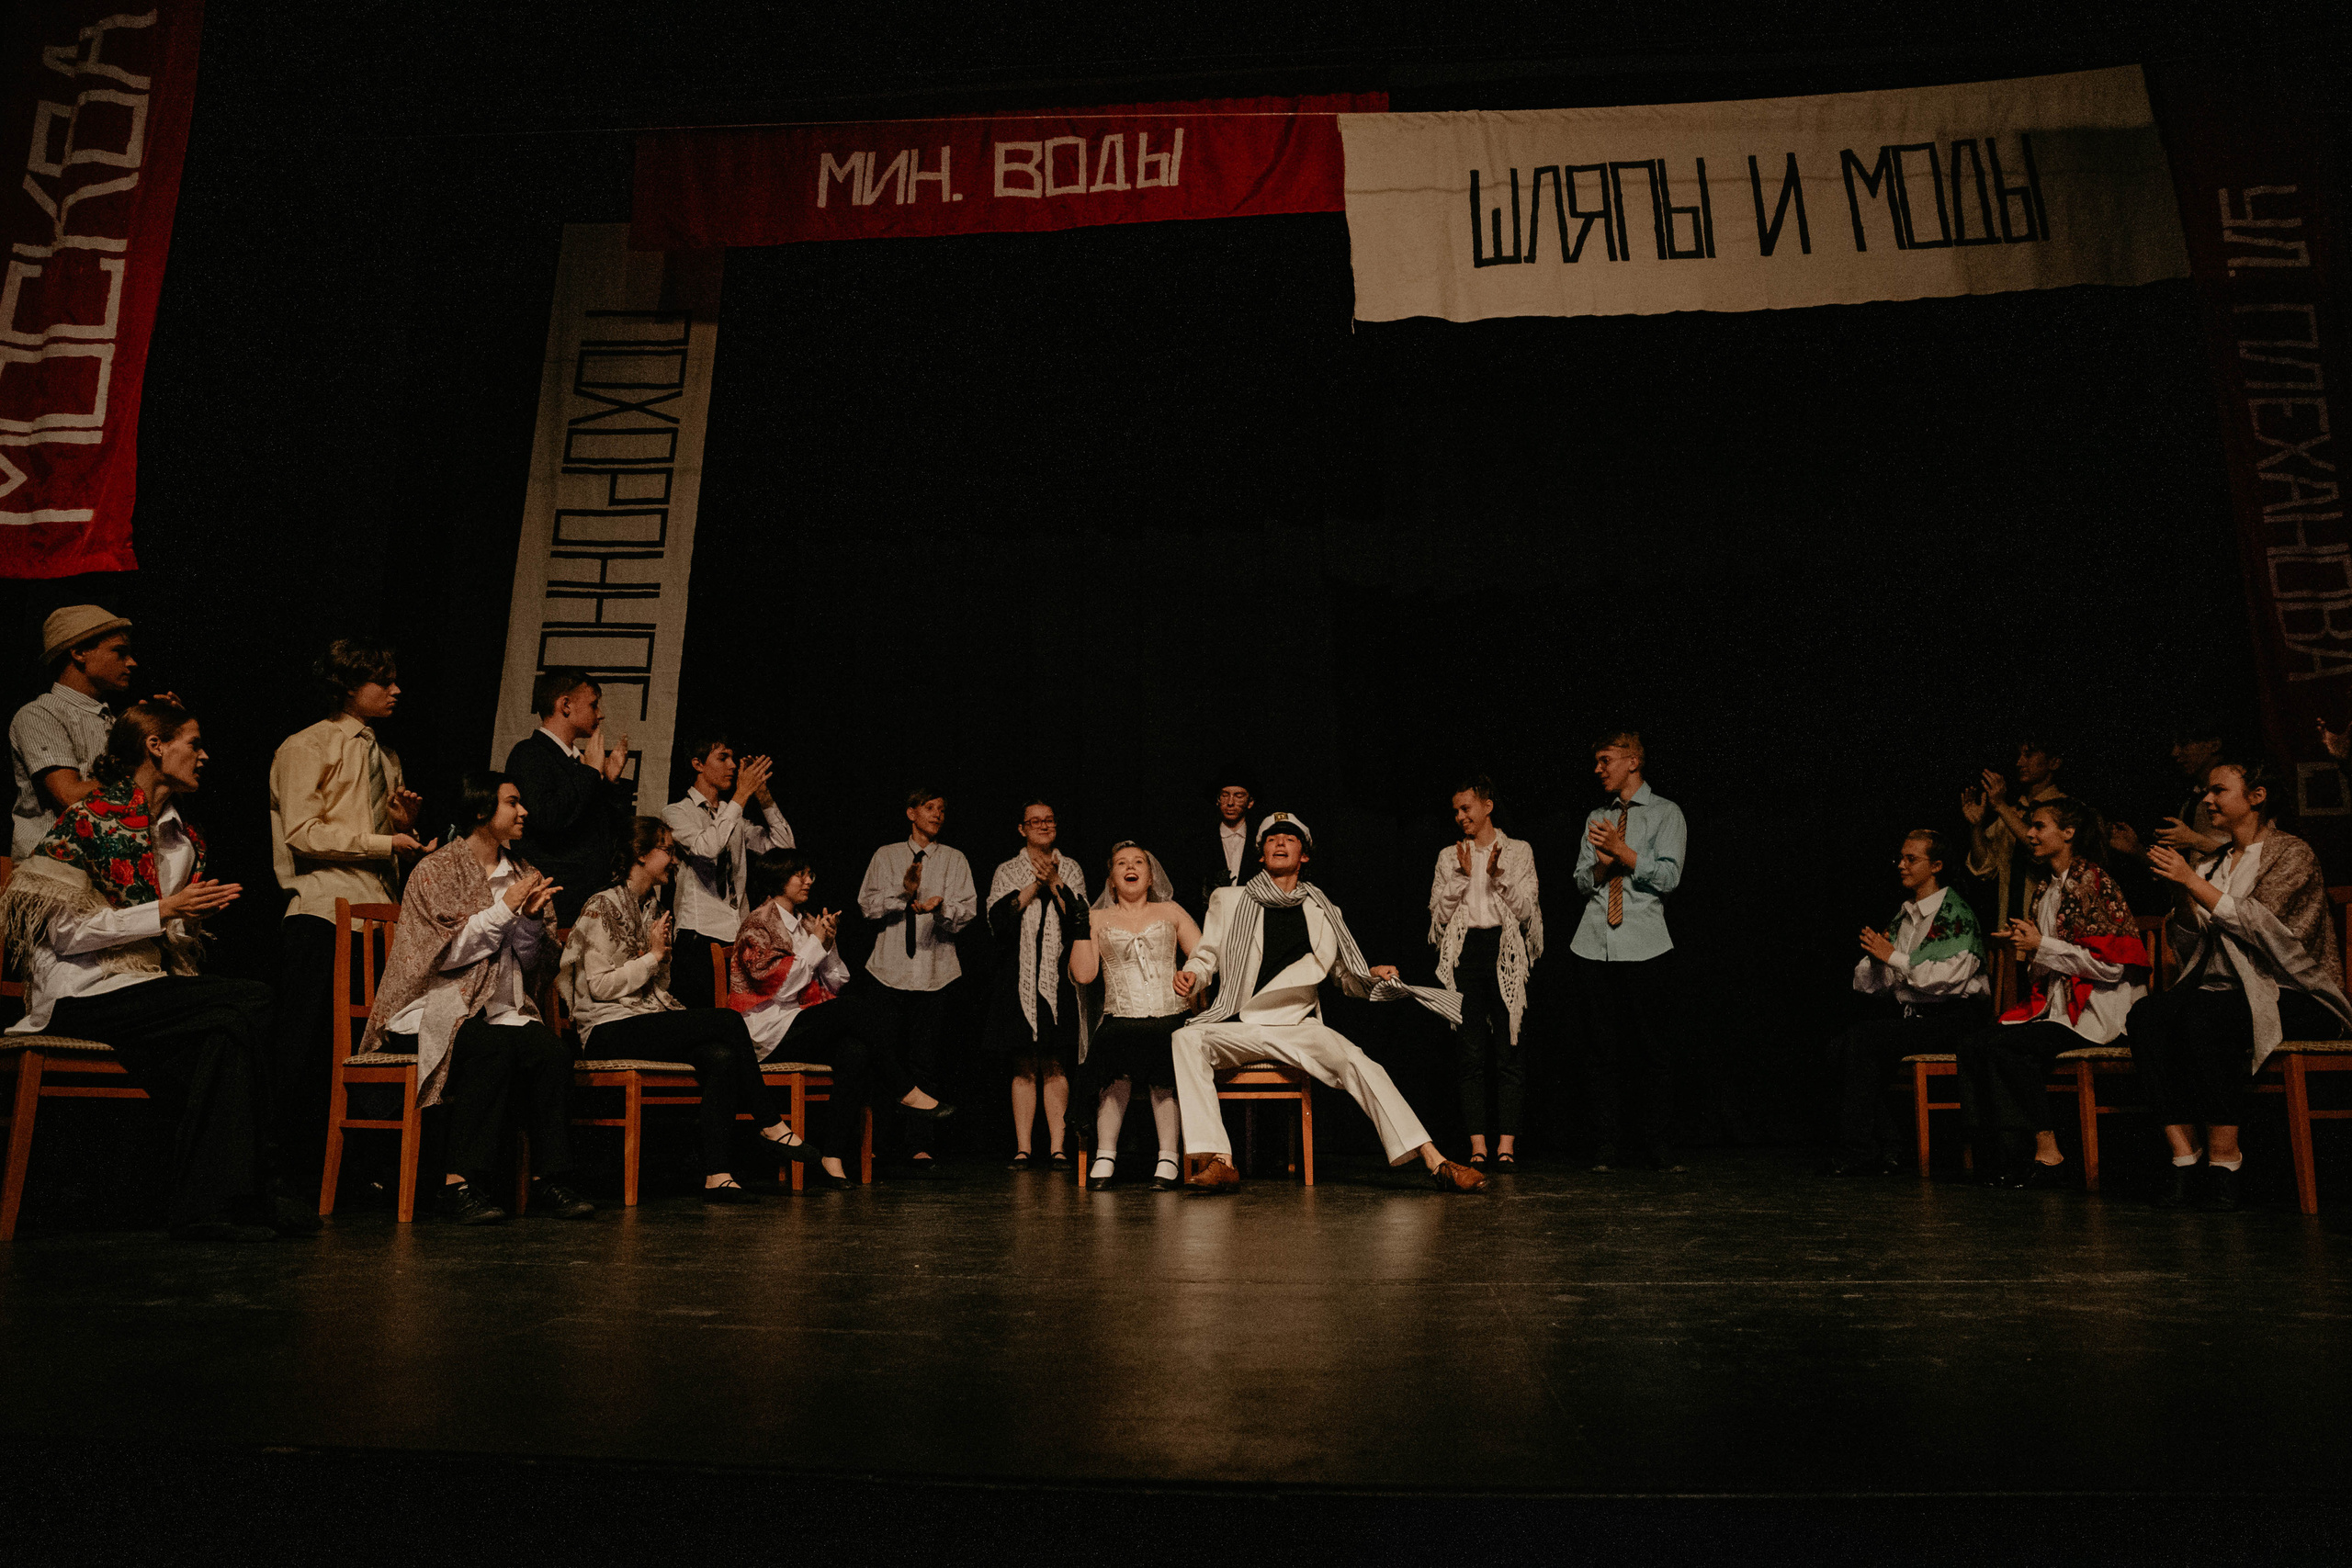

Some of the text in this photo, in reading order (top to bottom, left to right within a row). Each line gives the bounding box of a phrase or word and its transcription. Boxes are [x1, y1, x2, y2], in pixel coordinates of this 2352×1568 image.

[817, 127, 1184, 209] МИН. ВОДЫ
[1470, 133, 2050, 267] ШЛЯПЫ И МОДЫ
[2218, 184, 2311, 276] УЛ.
[0, 8, 157, 525] МОСКВА
[2232, 303, 2352, 682] ПЛЕХАНОВА
